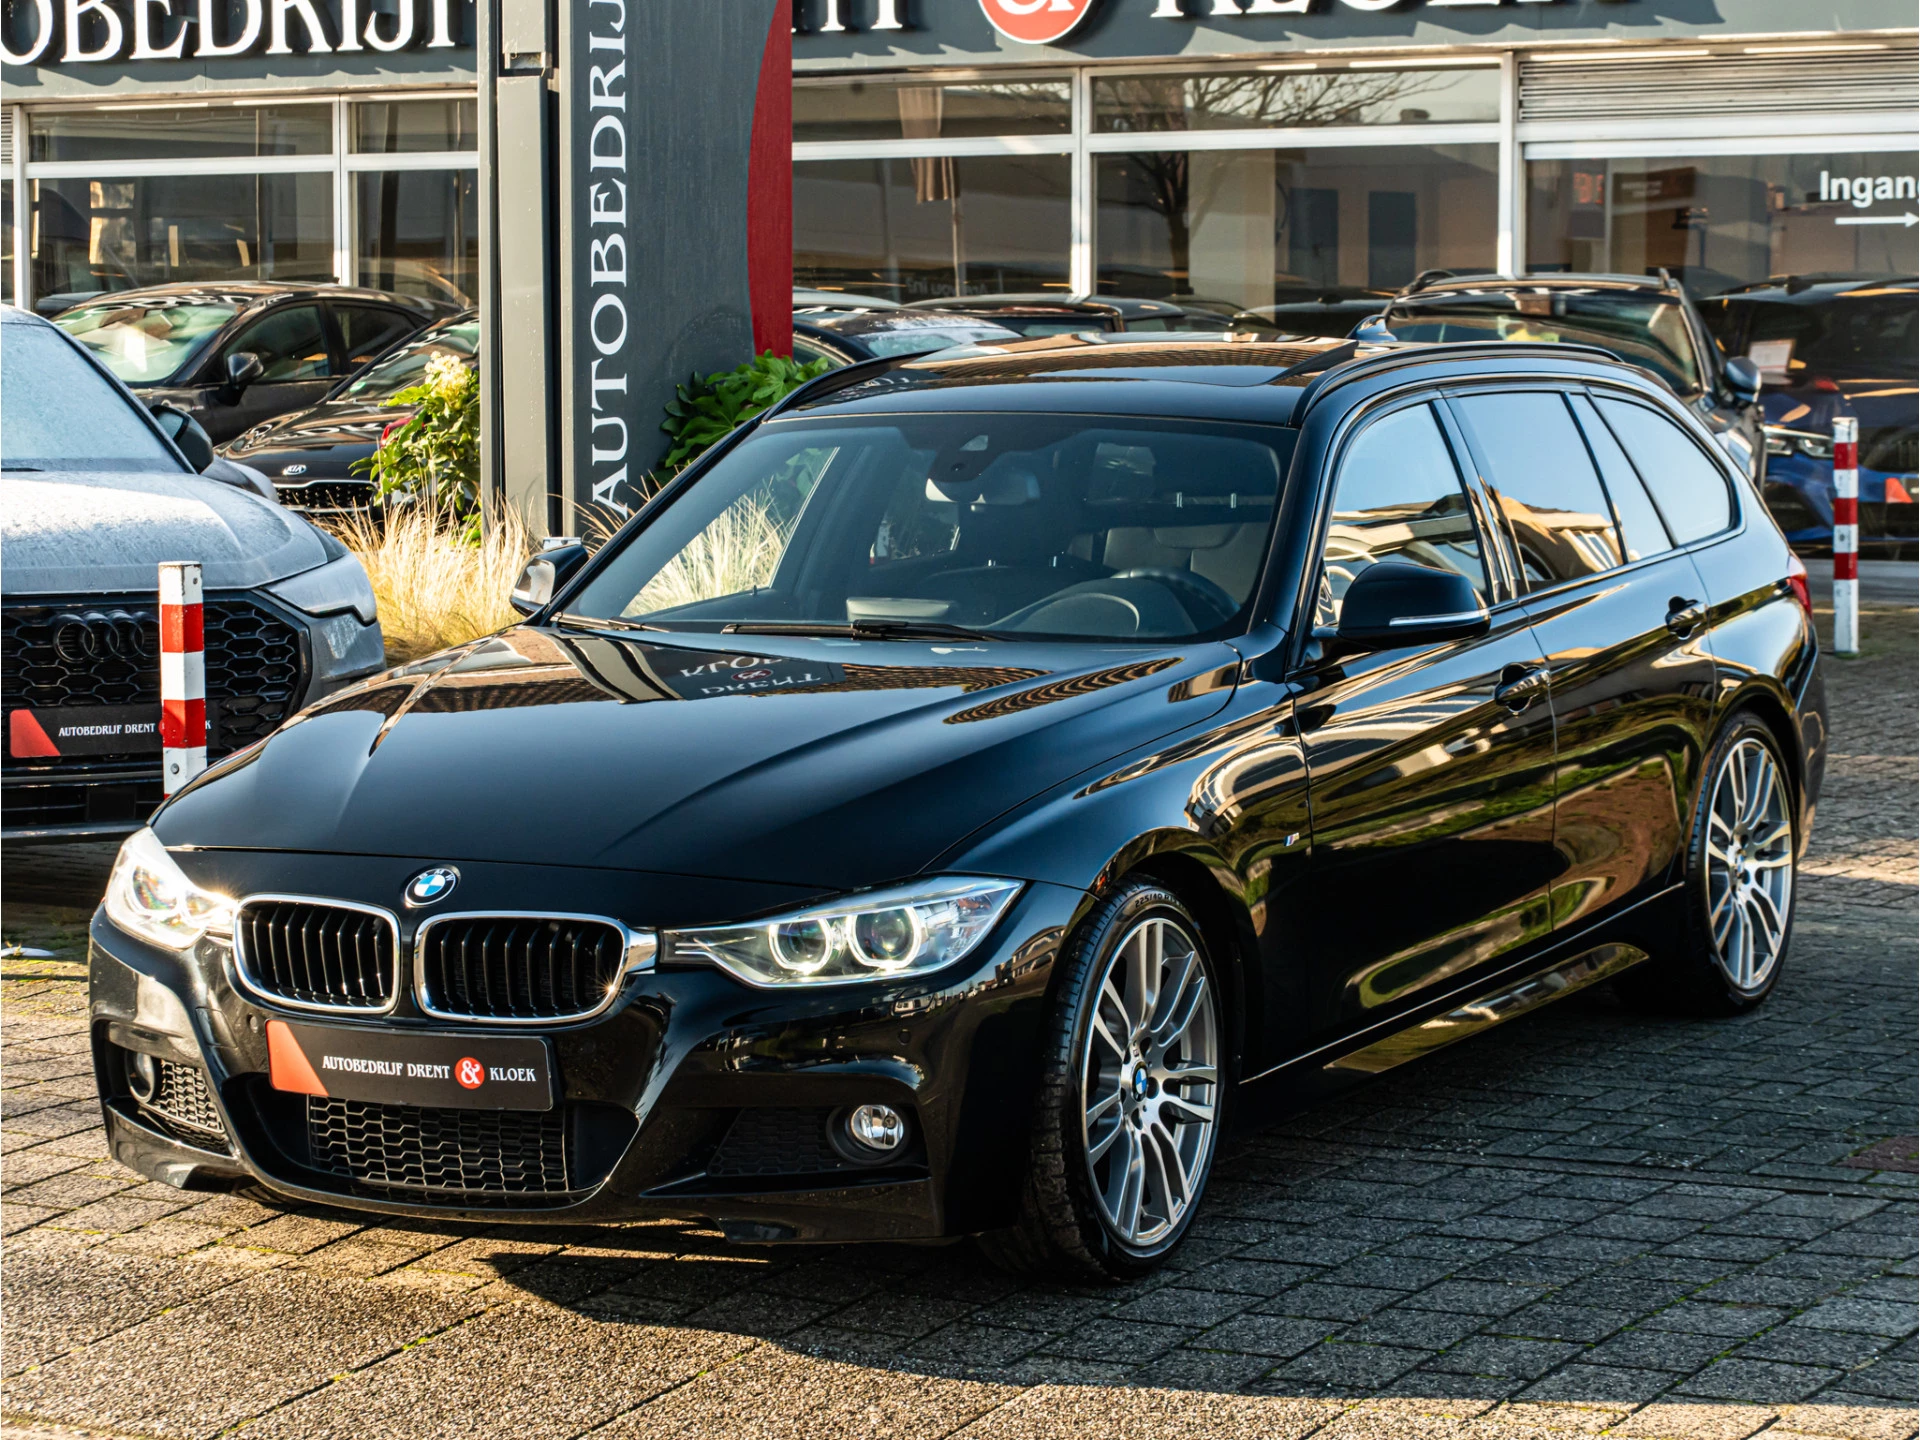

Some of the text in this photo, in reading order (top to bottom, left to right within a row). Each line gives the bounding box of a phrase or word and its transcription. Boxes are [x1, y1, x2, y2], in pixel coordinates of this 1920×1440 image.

[1820, 170, 1919, 208] Ingan
[58, 723, 156, 737] AUTOBEDRIJF DRENT
[322, 1055, 536, 1085] AUTOBEDRIJF DRENT & KLOEK
